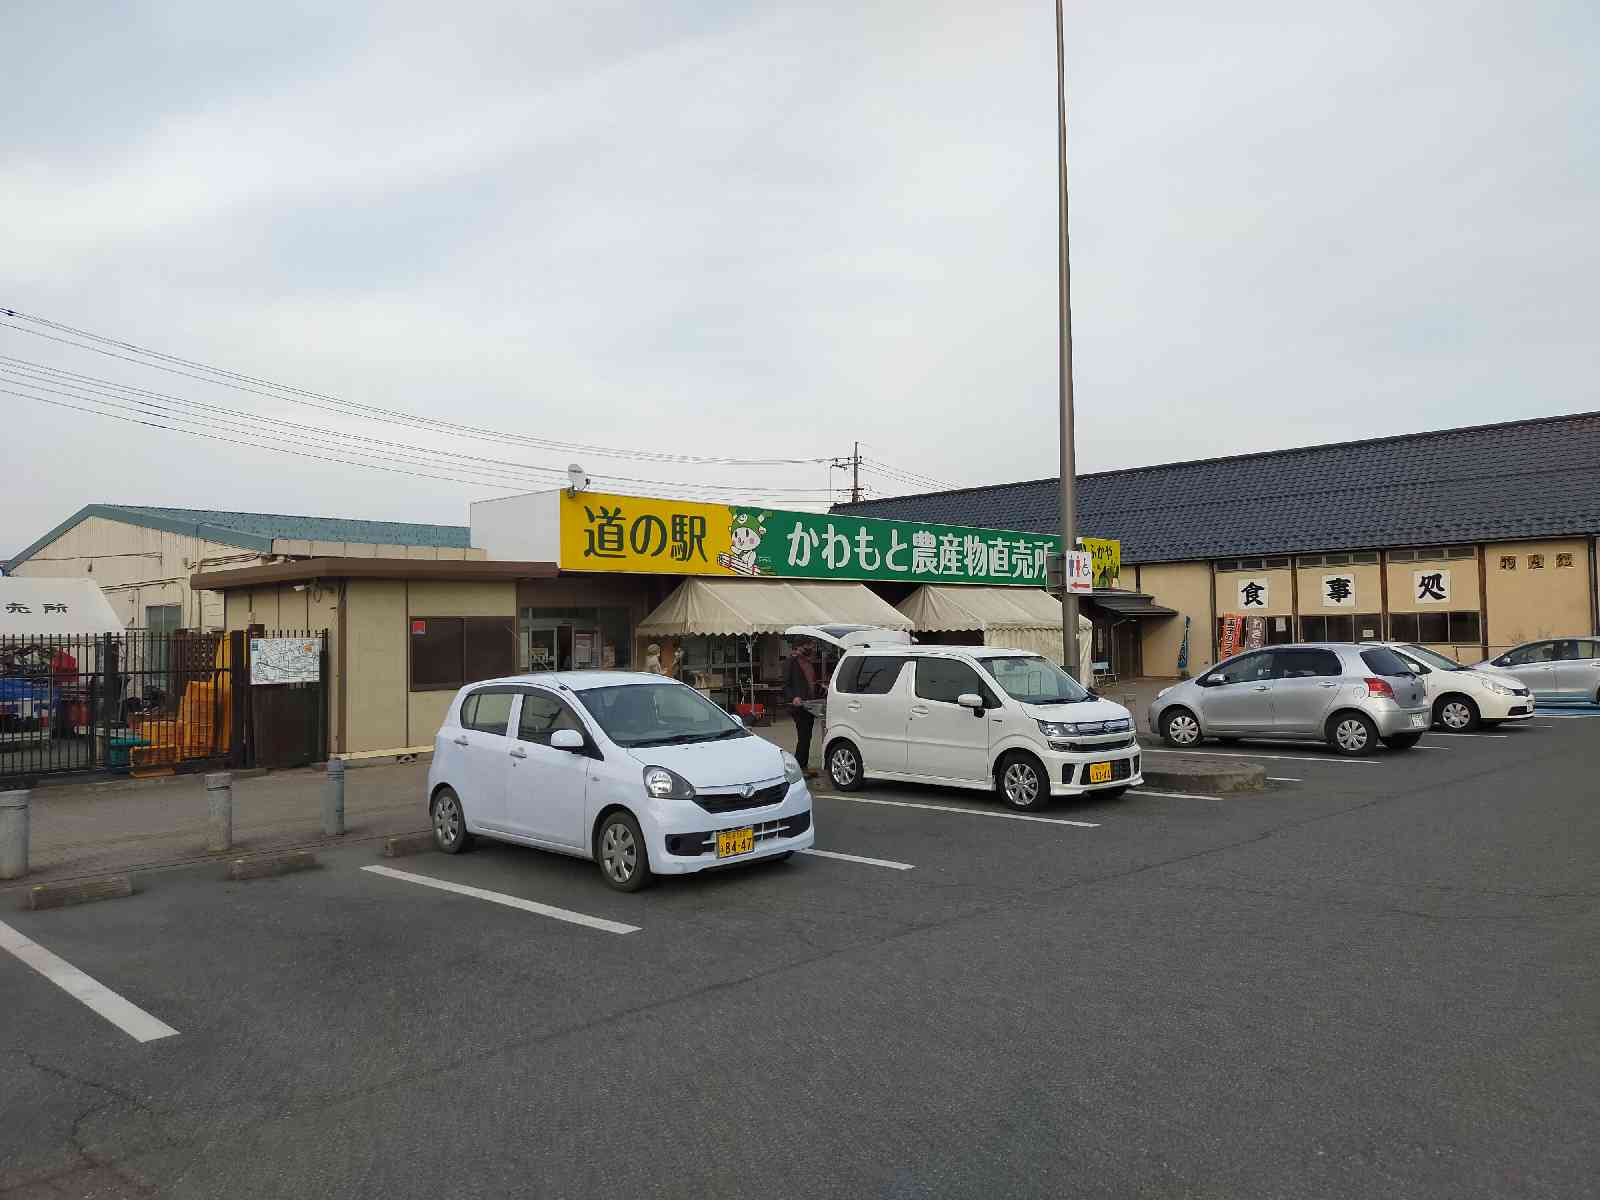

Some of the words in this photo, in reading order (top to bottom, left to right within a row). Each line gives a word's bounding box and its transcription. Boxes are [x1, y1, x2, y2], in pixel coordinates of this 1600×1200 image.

[583, 505, 709, 562] 道の駅
[786, 521, 1054, 579] かわもと農産物直売所
[1241, 573, 1446, 607] 食事処
